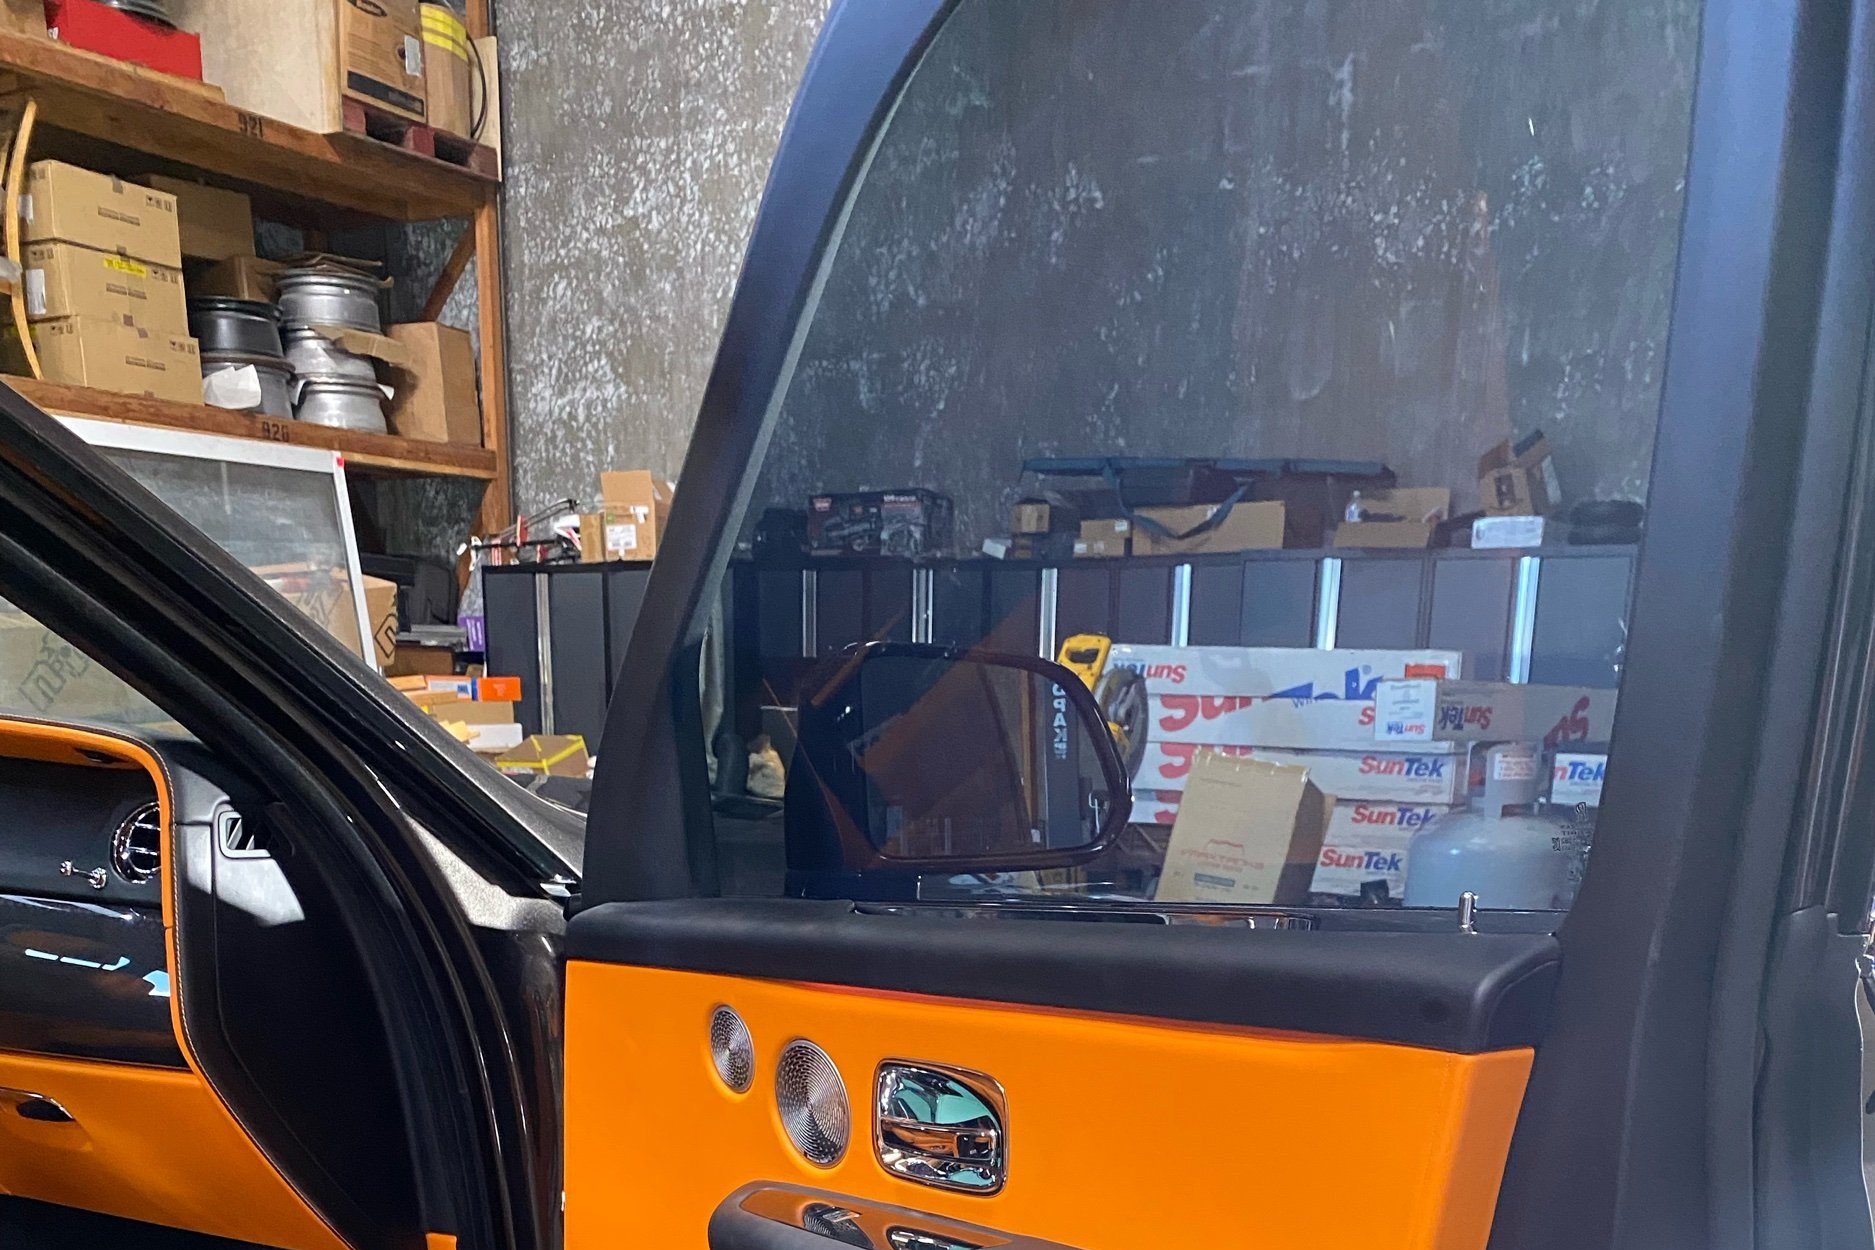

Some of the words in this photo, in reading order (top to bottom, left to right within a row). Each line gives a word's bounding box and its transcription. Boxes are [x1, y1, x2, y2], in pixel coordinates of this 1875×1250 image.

[1438, 703, 1494, 731] SunTek
[1358, 754, 1445, 778] SunTek
[1320, 848, 1402, 873] SunTek
